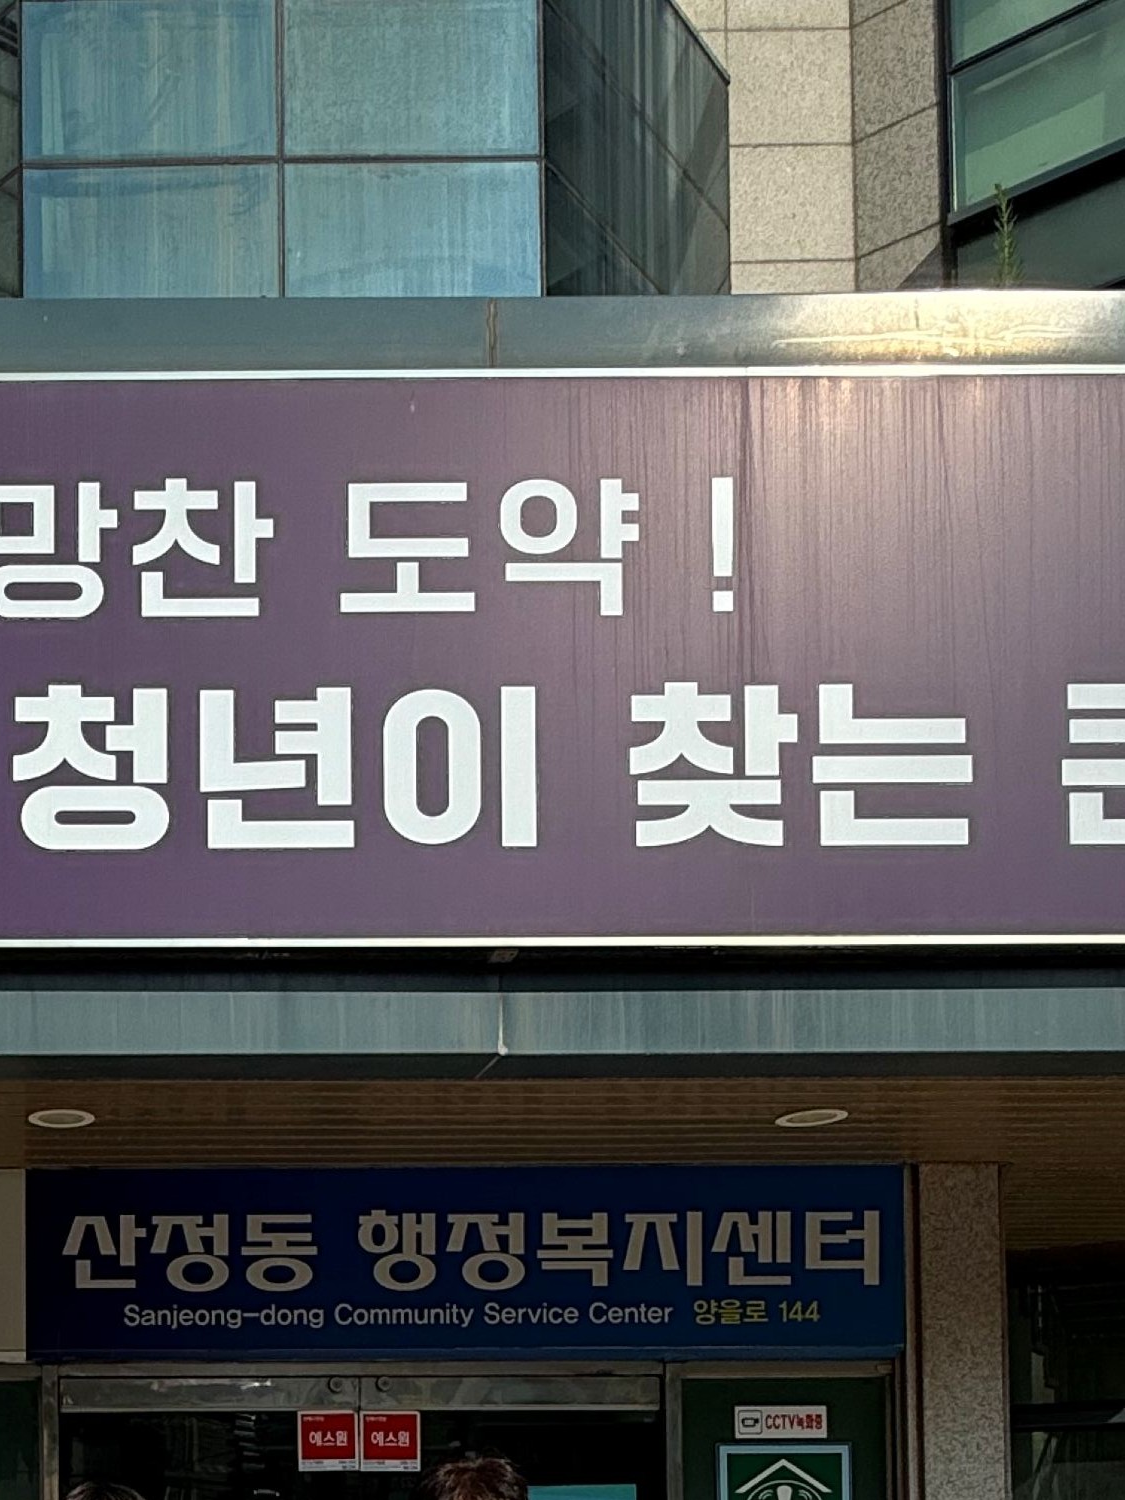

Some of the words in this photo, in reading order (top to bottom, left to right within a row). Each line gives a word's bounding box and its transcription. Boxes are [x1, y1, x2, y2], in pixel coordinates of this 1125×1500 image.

[340, 477, 640, 616] 도약
[11, 684, 538, 851] 청년이
[628, 681, 974, 848] 찾는
[62, 1211, 318, 1292] 산정동
[357, 1209, 882, 1292] 행정복지센터
[123, 1303, 325, 1329] Sanjeong-dong
[334, 1304, 475, 1328] Community
[483, 1302, 581, 1326] Service
[589, 1302, 674, 1325] Center
[692, 1299, 769, 1324] 양을로
[779, 1300, 821, 1323] 144
[308, 1430, 349, 1448] 에스원
[370, 1430, 411, 1448] 에스원
